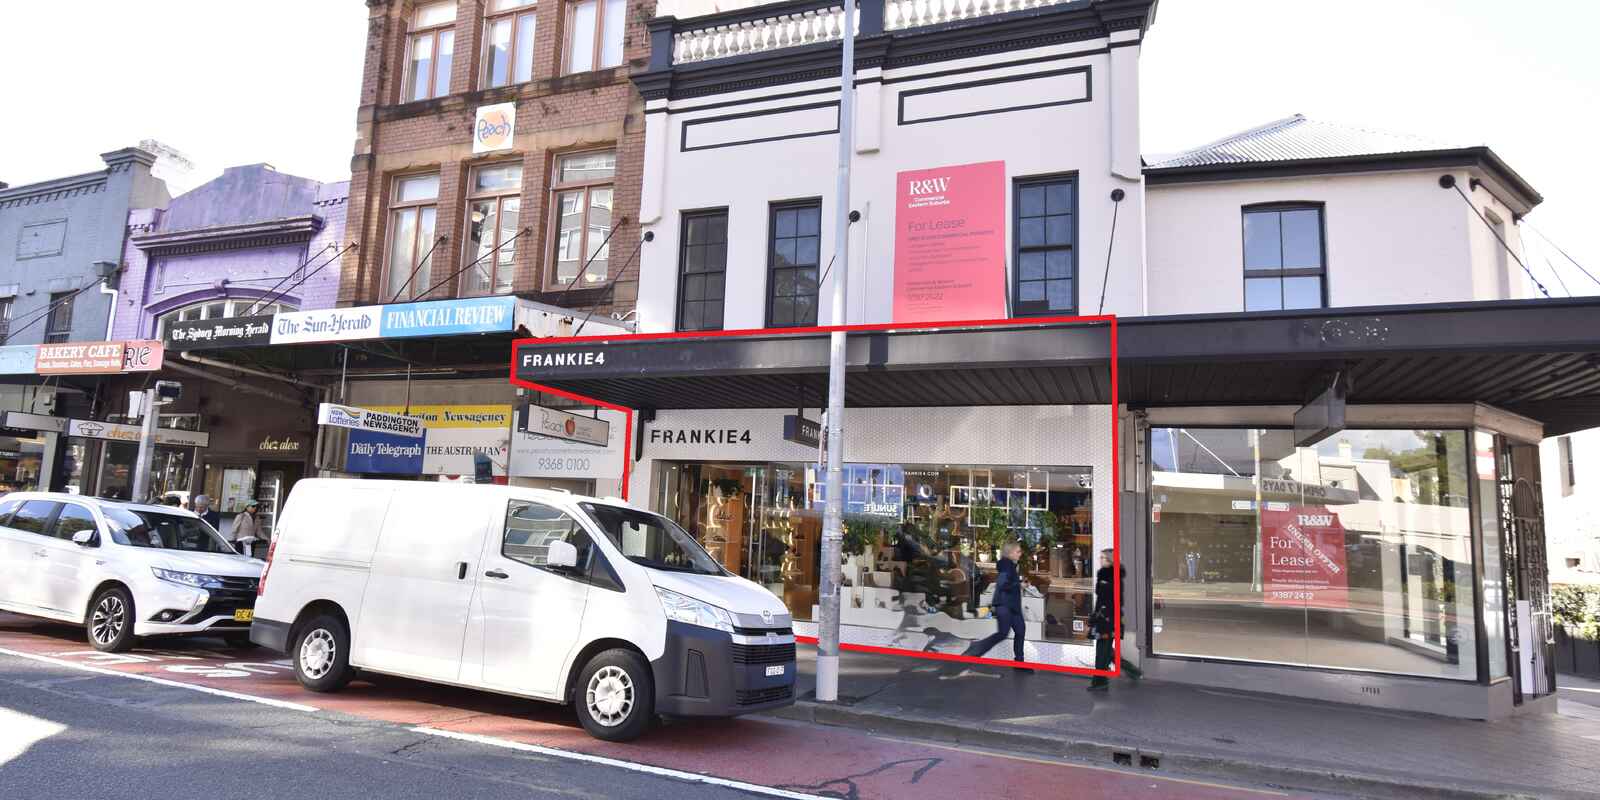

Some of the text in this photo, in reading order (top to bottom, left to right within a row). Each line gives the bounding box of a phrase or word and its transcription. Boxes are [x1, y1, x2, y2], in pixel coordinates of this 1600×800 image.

[909, 176, 952, 196] R&W
[930, 218, 966, 231] Lease
[386, 304, 506, 329] FINANCIAL REVIEW
[172, 322, 269, 341] The Sydney Morning Herald
[277, 314, 372, 335] The Sun-Herald
[40, 344, 121, 359] BAKERY CAFE
[522, 351, 606, 368] FRANKIE4
[328, 414, 361, 427] Lotteries
[366, 412, 419, 428] PADDINGTON
[443, 411, 506, 425] Newsagency
[363, 419, 420, 435] NEWSAGENCY
[650, 429, 752, 444] FRANKIE4
[351, 443, 421, 458] Daily Telegraph
[426, 446, 444, 455] THE
[538, 457, 591, 471] 9368 0100
[1297, 514, 1334, 526] R&W
[1270, 536, 1294, 549] For
[1271, 553, 1314, 567] Lease
